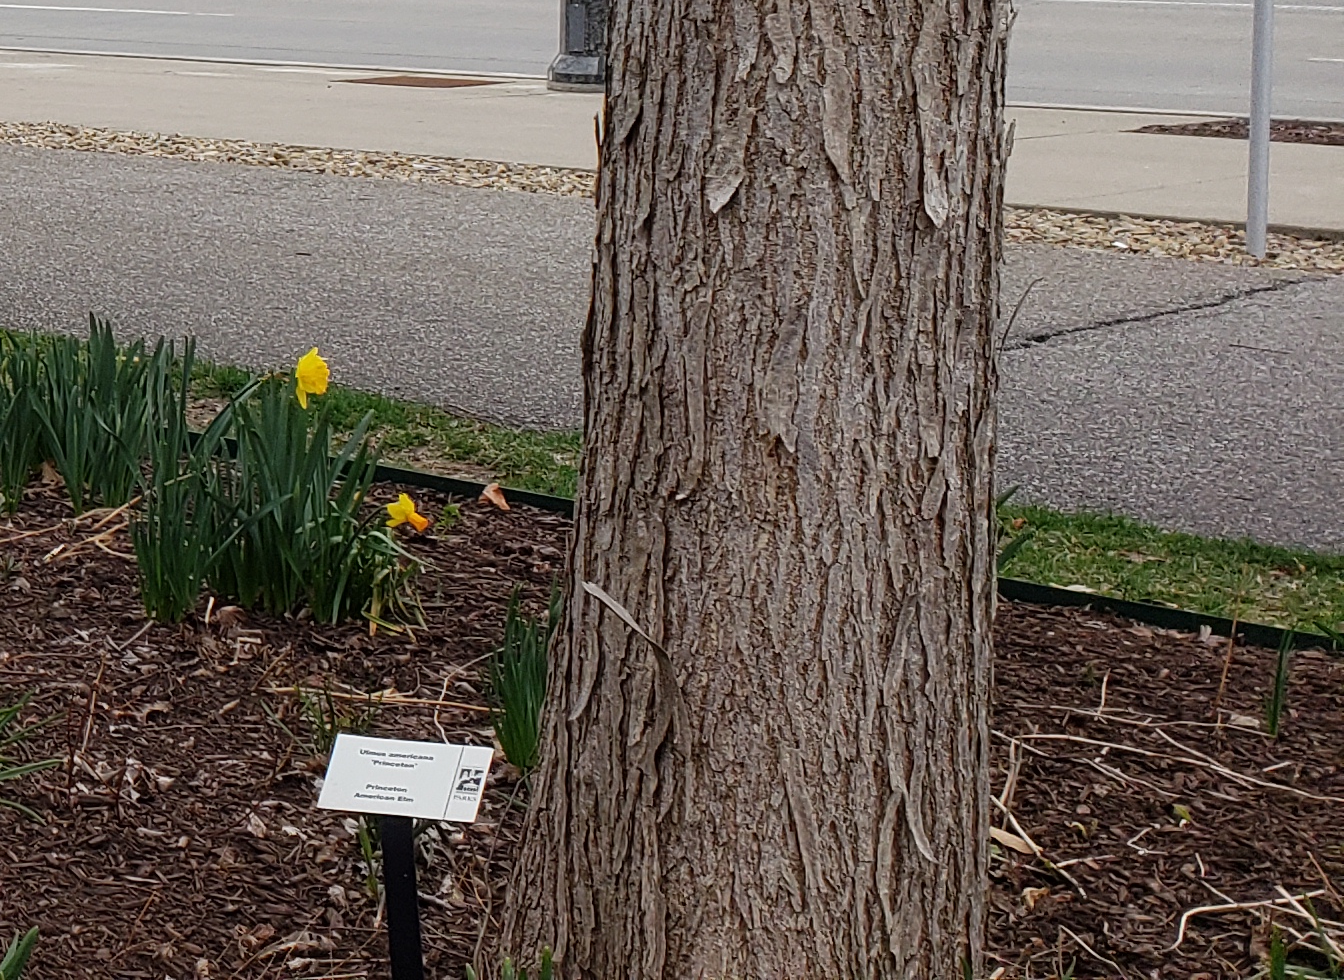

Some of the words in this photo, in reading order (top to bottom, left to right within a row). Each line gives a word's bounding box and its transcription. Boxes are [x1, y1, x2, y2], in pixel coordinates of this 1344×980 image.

[359, 749, 387, 757] Ulmus
[388, 752, 434, 761] americana
[366, 783, 408, 793] Princeton
[354, 792, 395, 801] American
